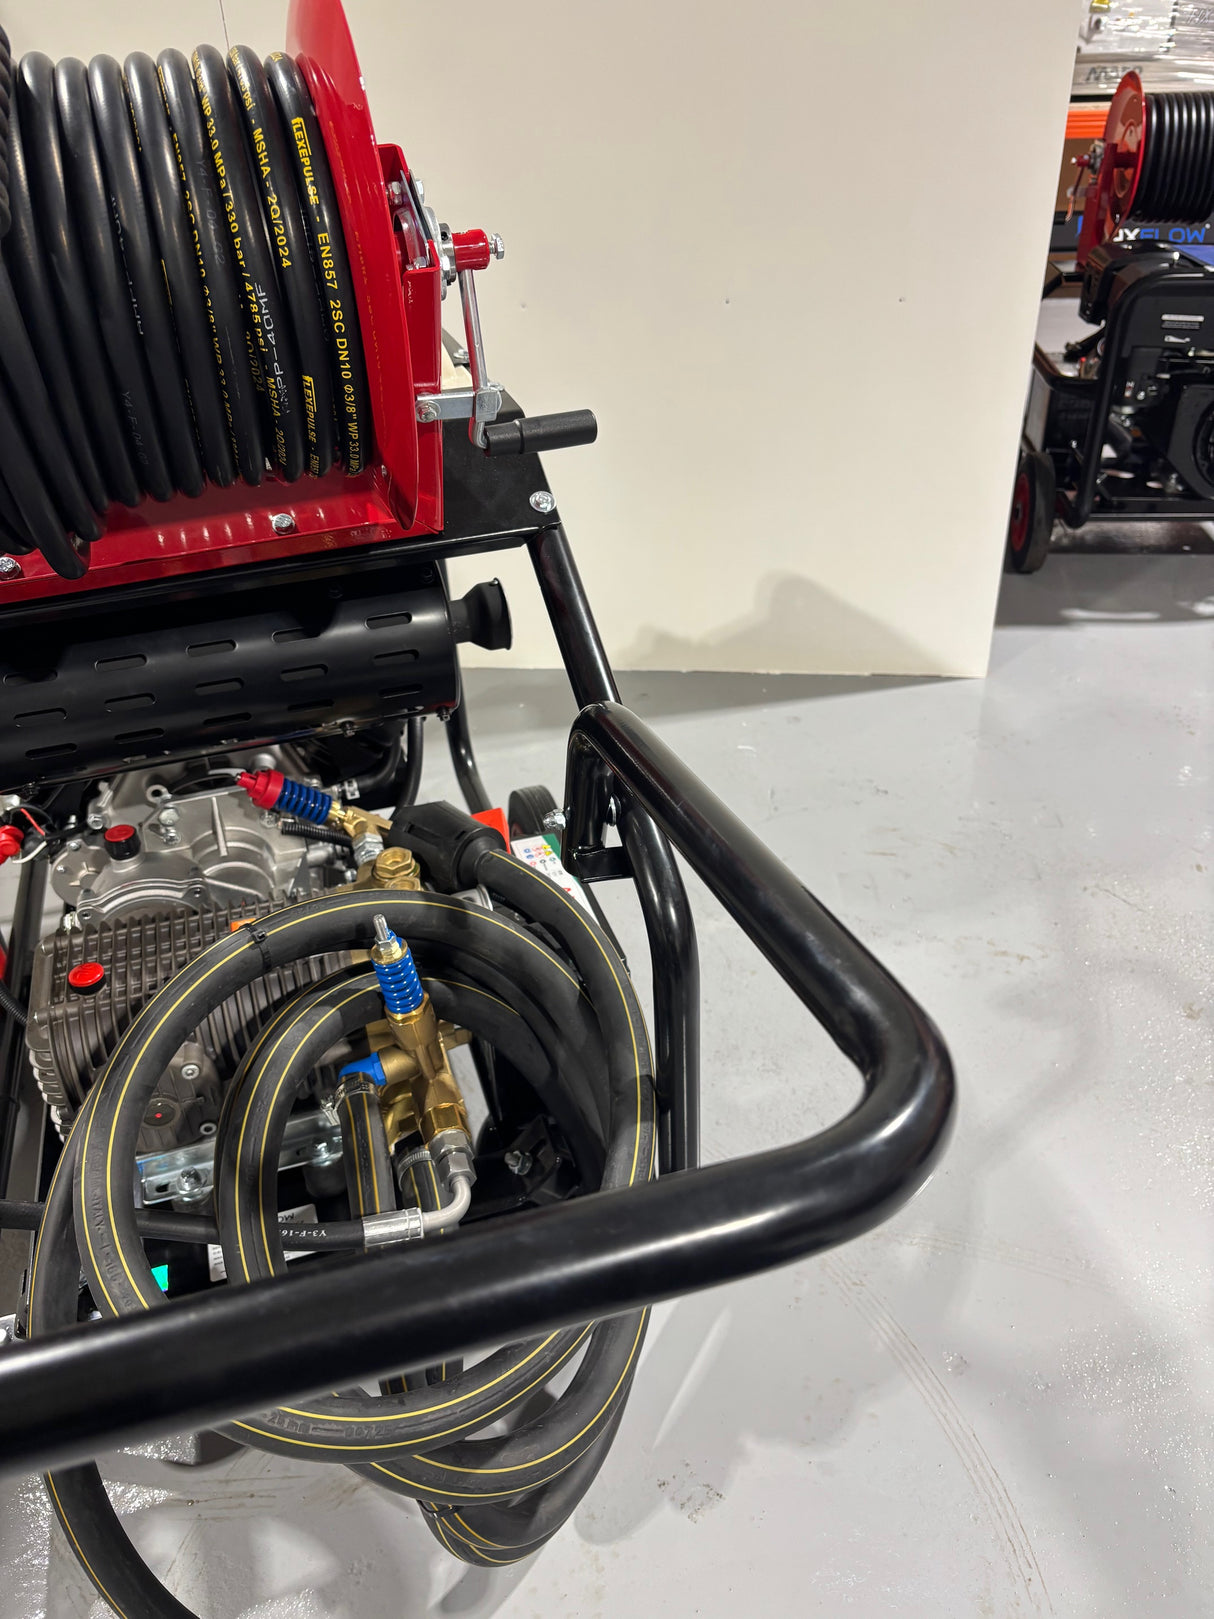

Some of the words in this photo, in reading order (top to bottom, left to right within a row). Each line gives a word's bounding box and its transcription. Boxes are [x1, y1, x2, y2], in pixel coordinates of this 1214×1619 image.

[201, 96, 212, 116] WP
[206, 118, 219, 150] 33.0
[214, 151, 227, 189] MPa
[291, 117, 320, 205] FLEXEPULSE
[253, 128, 271, 179] MSHA
[267, 194, 292, 268] 2Q/2024
[225, 201, 239, 233] 330
[234, 237, 246, 268] bar
[318, 233, 338, 290] EN857
[245, 281, 262, 324] 4785
[329, 300, 345, 333] 2SC
[255, 328, 268, 352] psi
[336, 338, 352, 379] DN10
[267, 376, 281, 417] MSHA
[347, 422, 359, 440] WP
[350, 441, 360, 458] 33.0
